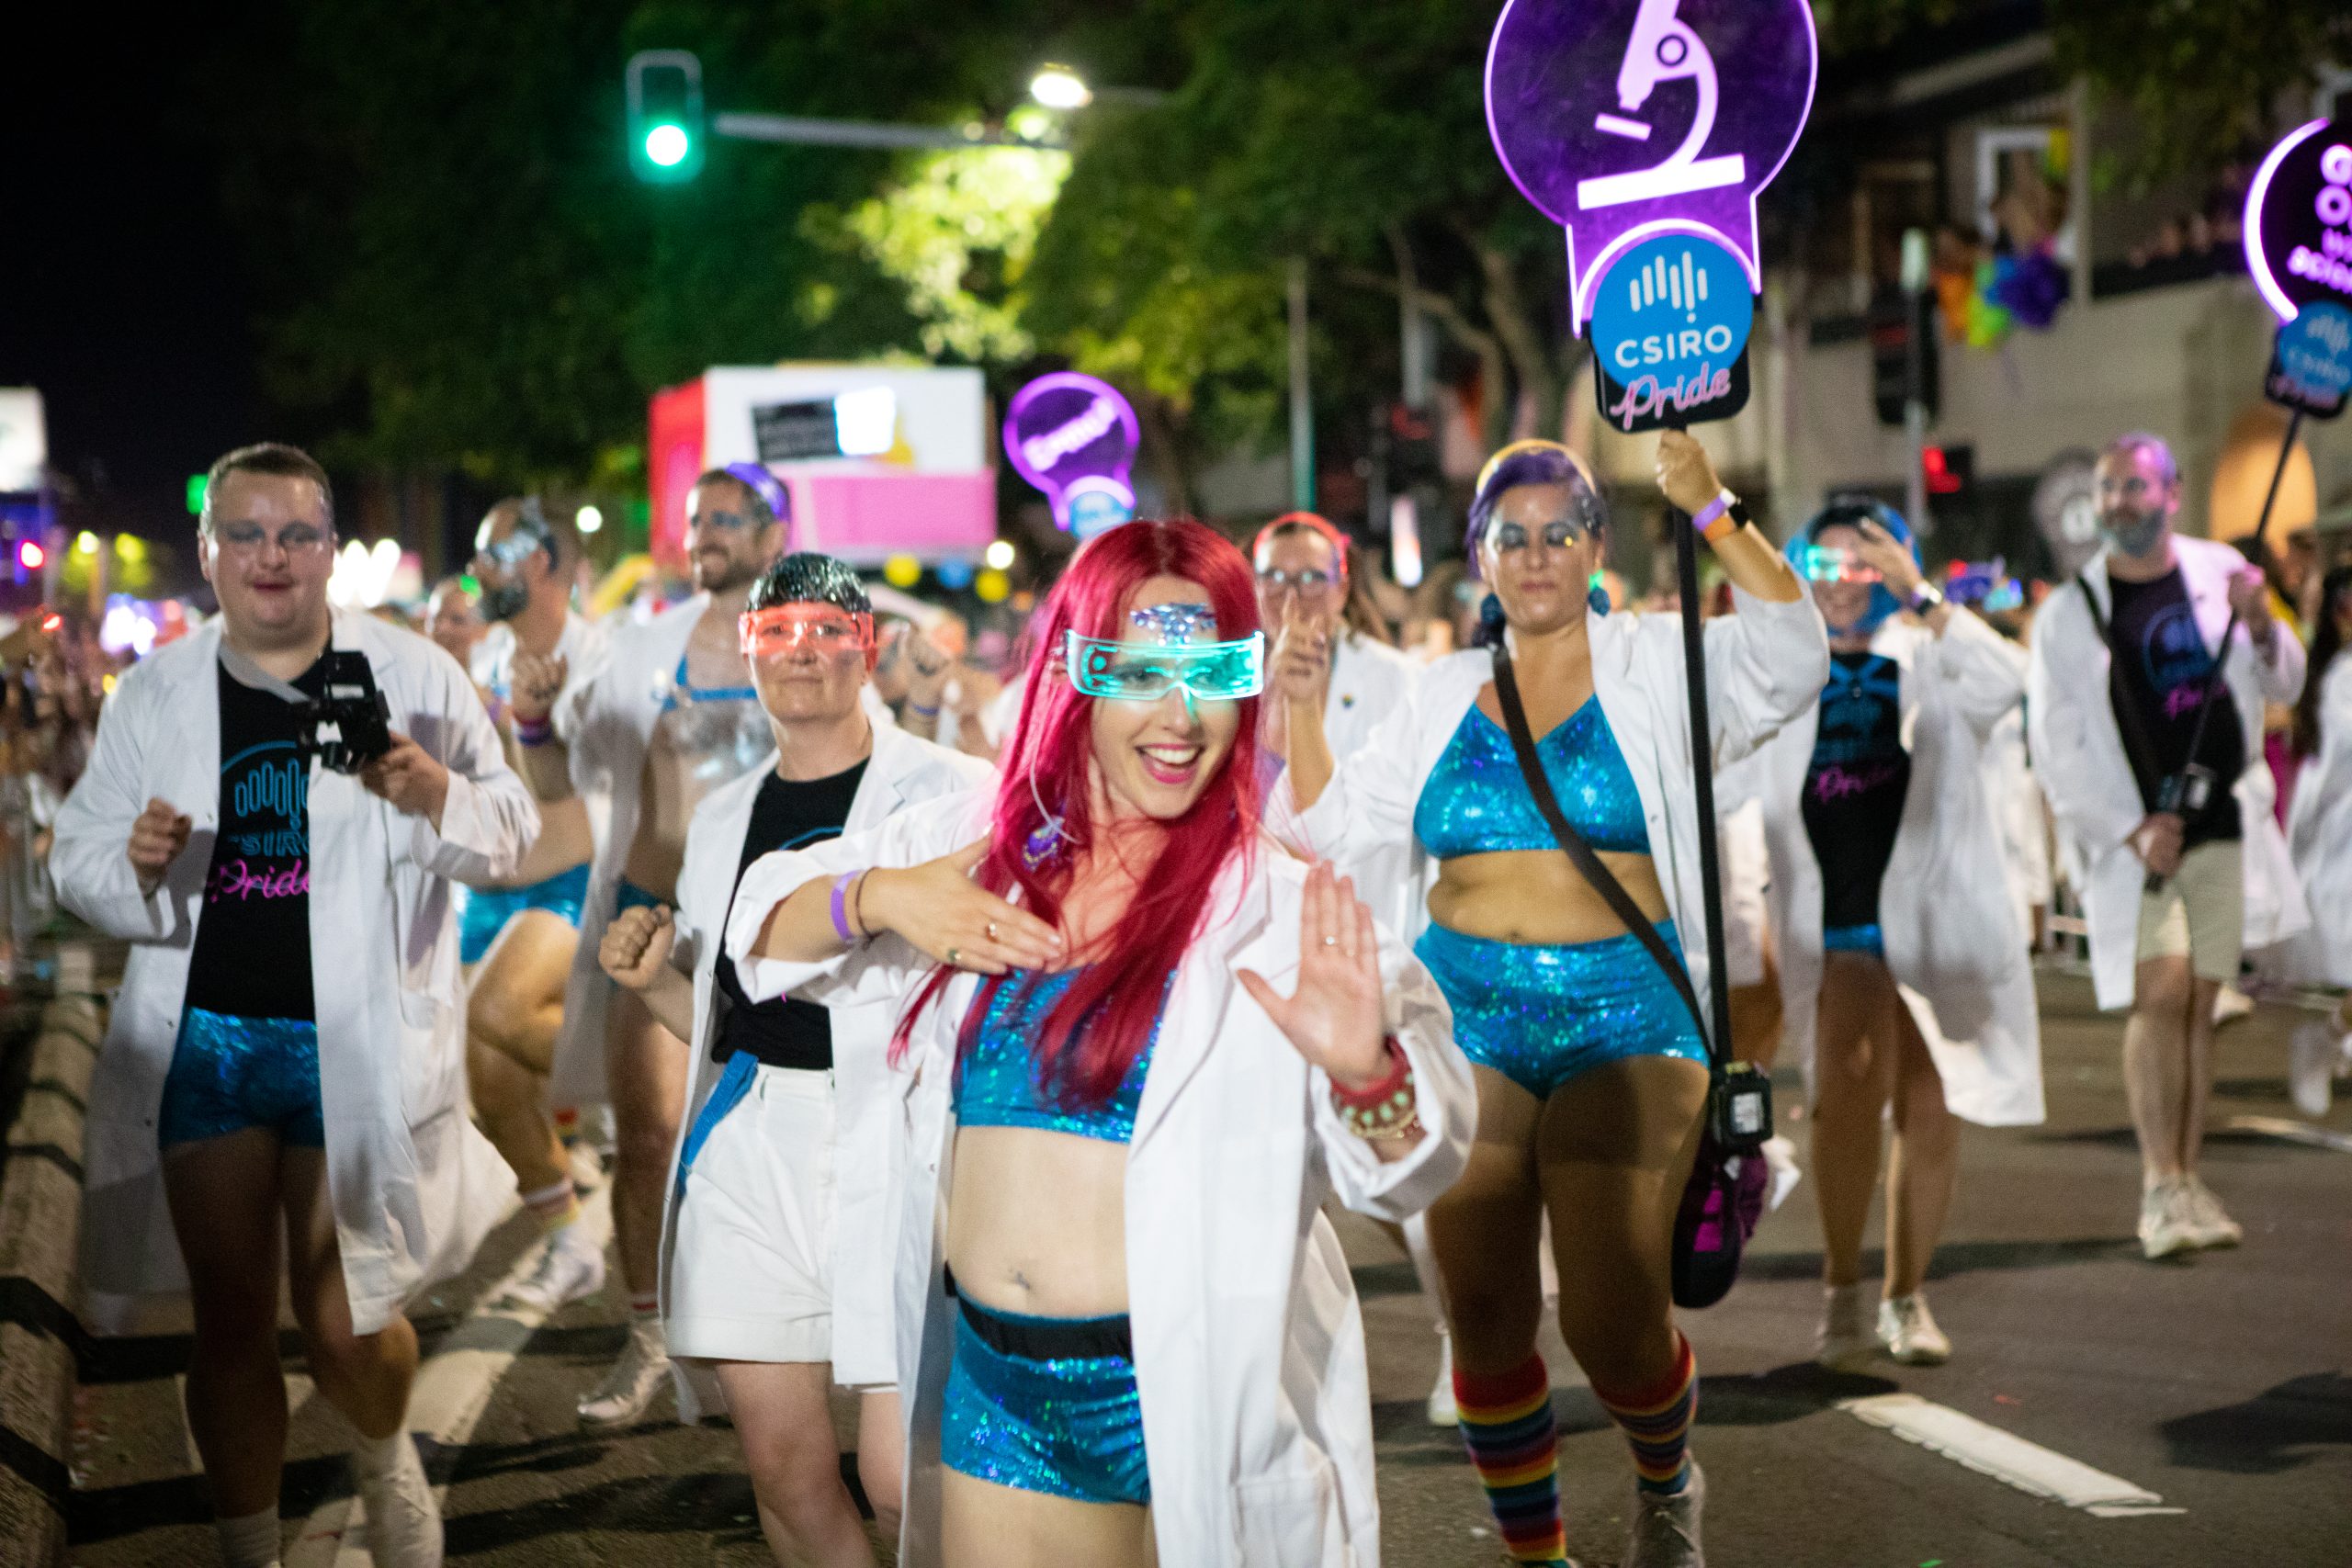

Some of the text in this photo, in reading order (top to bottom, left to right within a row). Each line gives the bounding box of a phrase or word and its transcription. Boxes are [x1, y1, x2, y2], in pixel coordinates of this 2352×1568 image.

[1615, 324, 1733, 368] CSIRO
[1610, 362, 1732, 432] Pride
[228, 829, 310, 857] SIR
